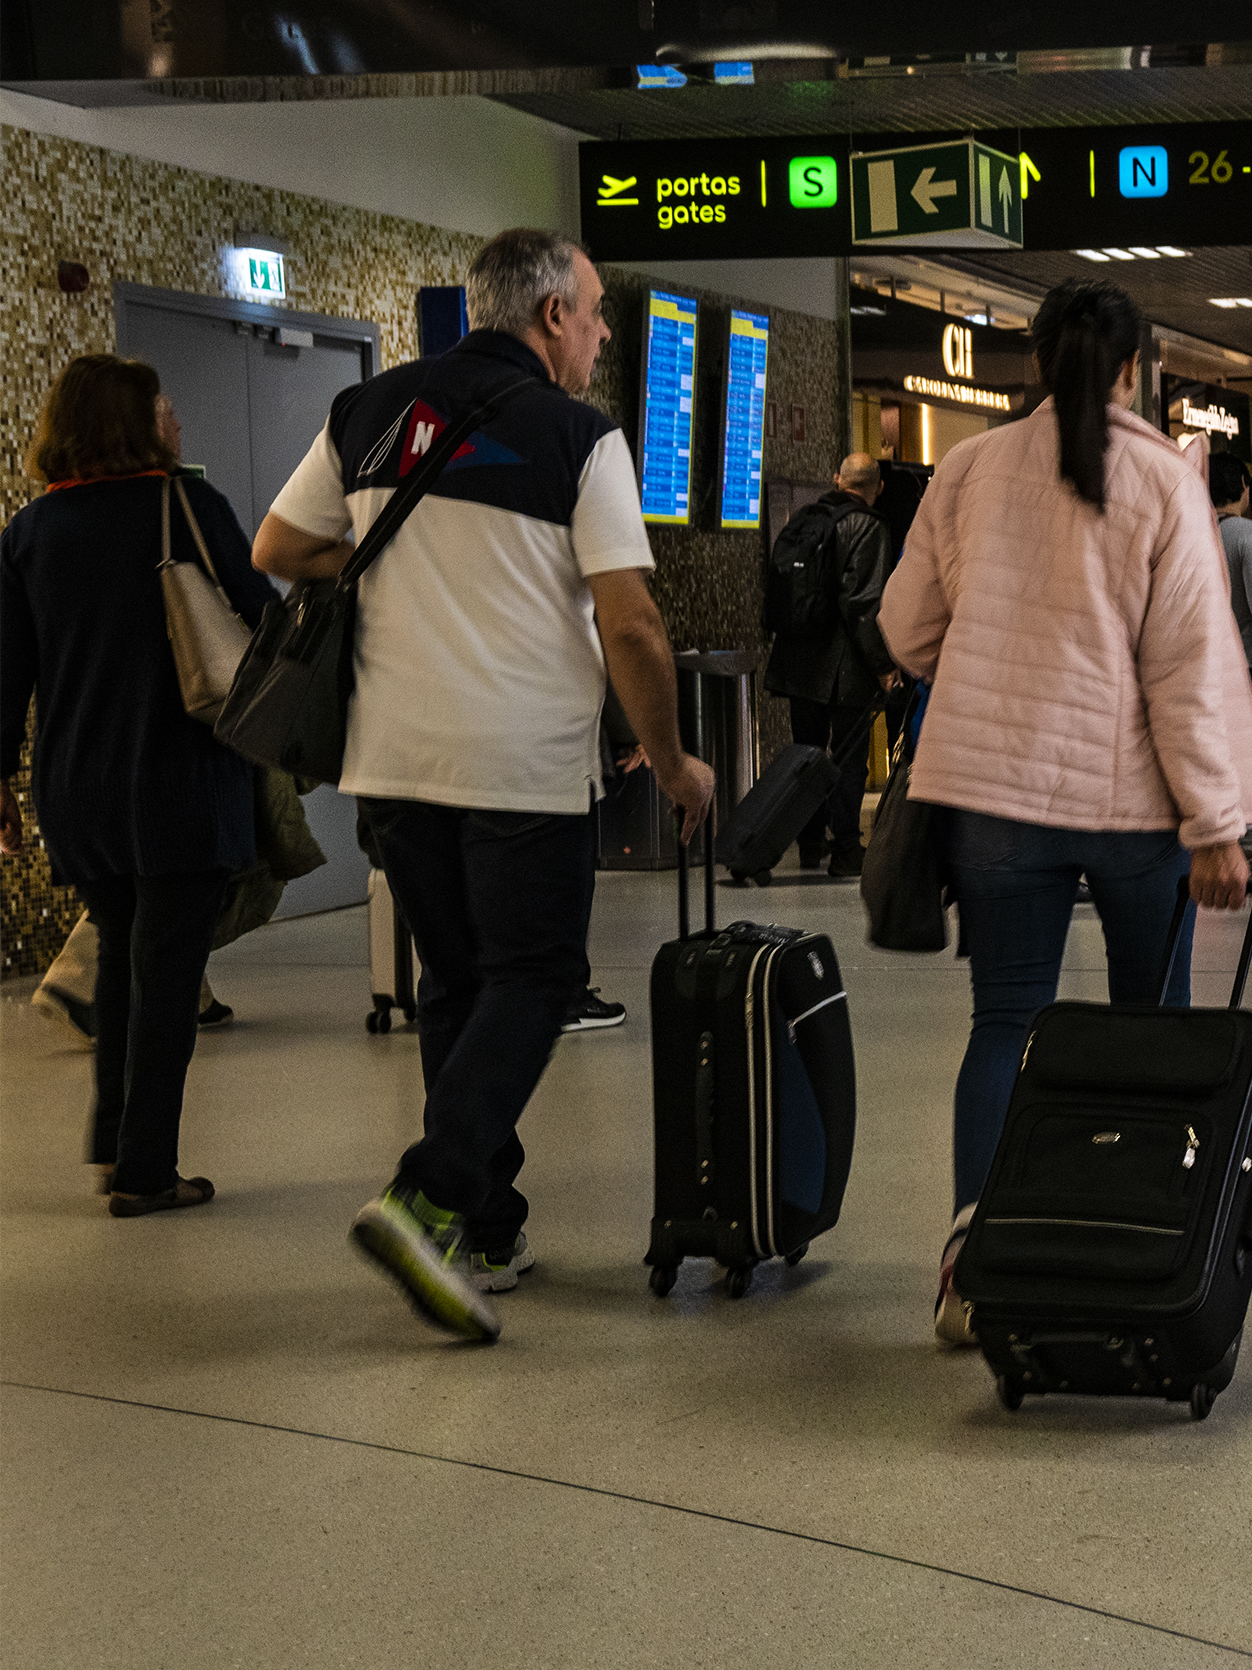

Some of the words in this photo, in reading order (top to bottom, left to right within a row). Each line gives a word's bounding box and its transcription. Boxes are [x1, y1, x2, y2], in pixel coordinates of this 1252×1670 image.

[803, 167, 823, 197] S
[1132, 157, 1156, 188] N
[1189, 151, 1233, 183] 26
[656, 173, 741, 202] portas
[657, 201, 727, 230] gates
